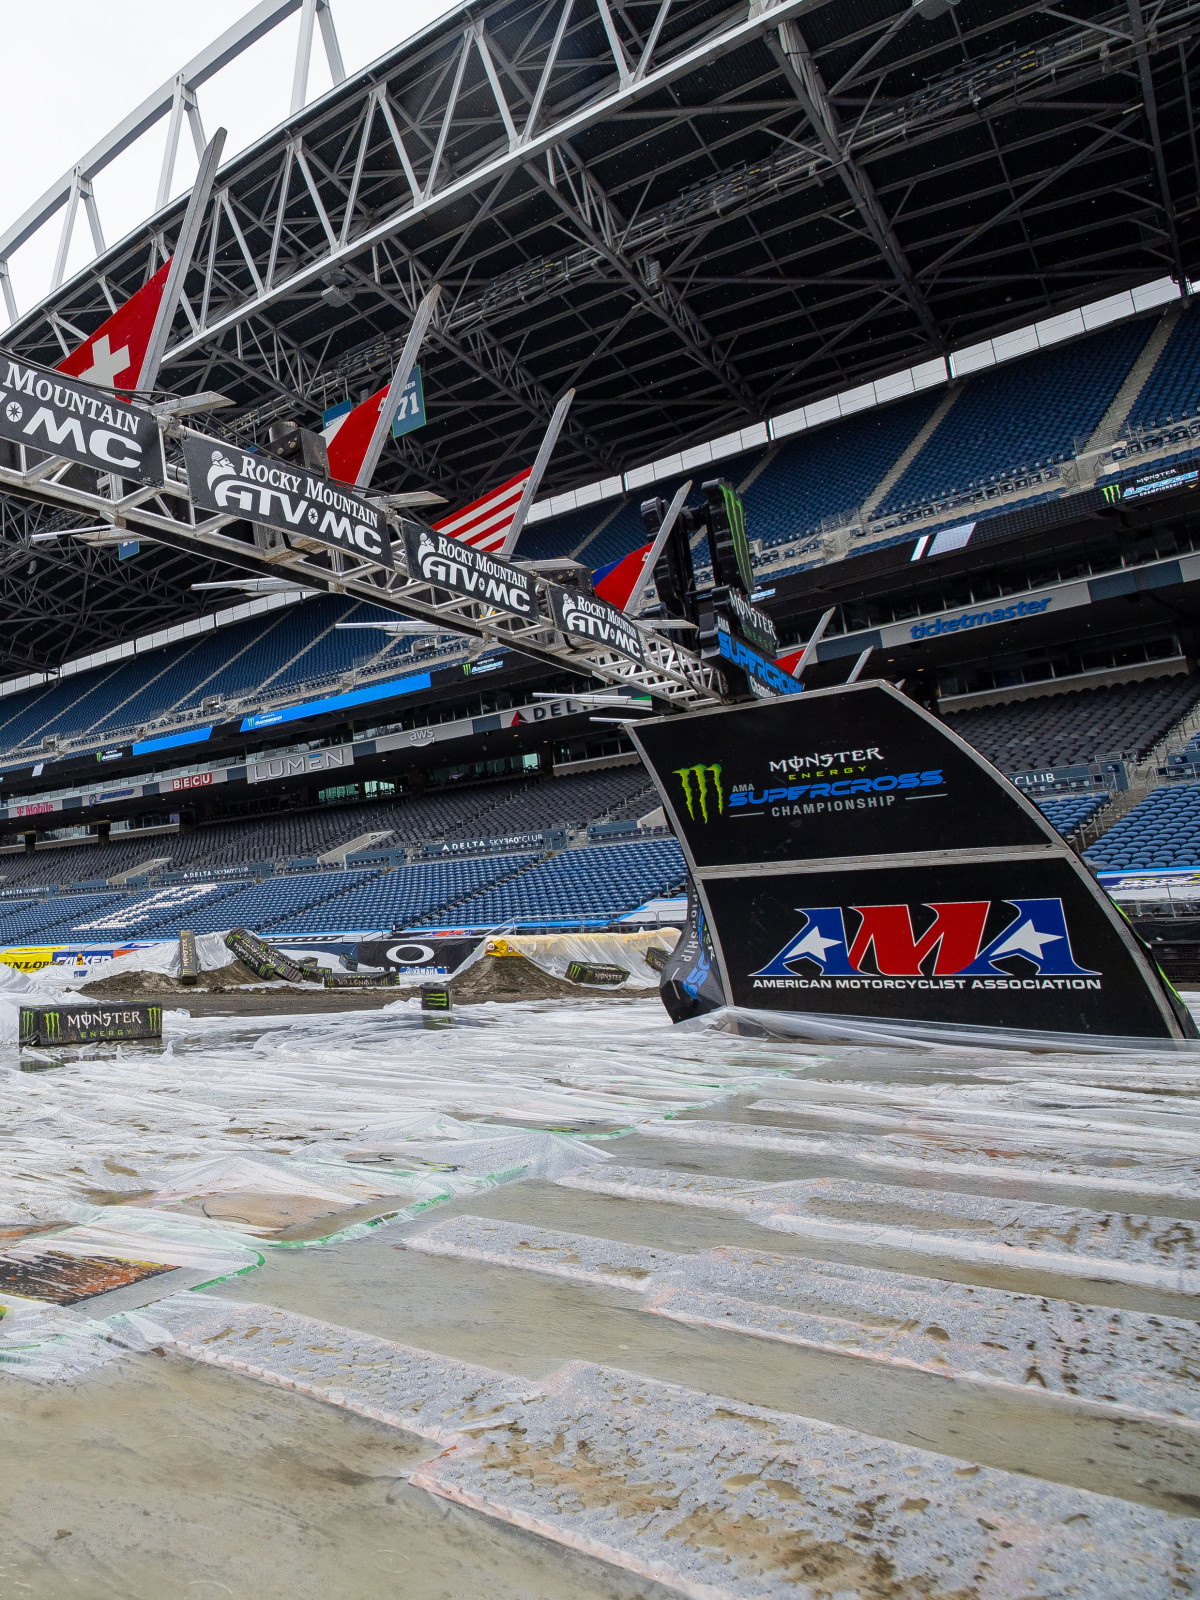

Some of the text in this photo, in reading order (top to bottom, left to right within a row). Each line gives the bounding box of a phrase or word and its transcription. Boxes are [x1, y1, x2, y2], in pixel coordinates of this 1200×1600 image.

[3, 362, 141, 436] MOUNTAIN
[397, 391, 420, 421] 71
[214, 479, 309, 525] ATV
[240, 455, 379, 529] ROCKY MOUNTAIN
[422, 556, 479, 592] ATV
[438, 536, 528, 590] ROCKY MOUNTAIN
[577, 596, 606, 620] ROCKY
[728, 589, 778, 641] MONSTER
[910, 597, 1053, 640] ticketmaster
[533, 700, 599, 721] DEL
[410, 728, 434, 742] aws
[254, 749, 346, 781] LUMEN
[768, 747, 885, 773] MONSTER
[173, 774, 211, 789] BECU
[788, 765, 868, 781] ENERGY
[728, 769, 944, 807] SUPERCROSS
[732, 783, 755, 793] AMA
[26, 801, 54, 816] Mobile
[771, 795, 896, 817] CHAMPIONSHIP
[451, 841, 485, 851] DELTA
[189, 870, 212, 878] DELTA
[747, 897, 1103, 977] AMA
[4, 960, 50, 969] UNLOP
[233, 942, 259, 968] MONSTER
[593, 972, 623, 982] MONSTER
[753, 979, 1102, 990] AMERICAN MOTORCYCLIST ASSOCIATION
[67, 1010, 143, 1029] MONSTER
[80, 1029, 132, 1039] ENERGY
